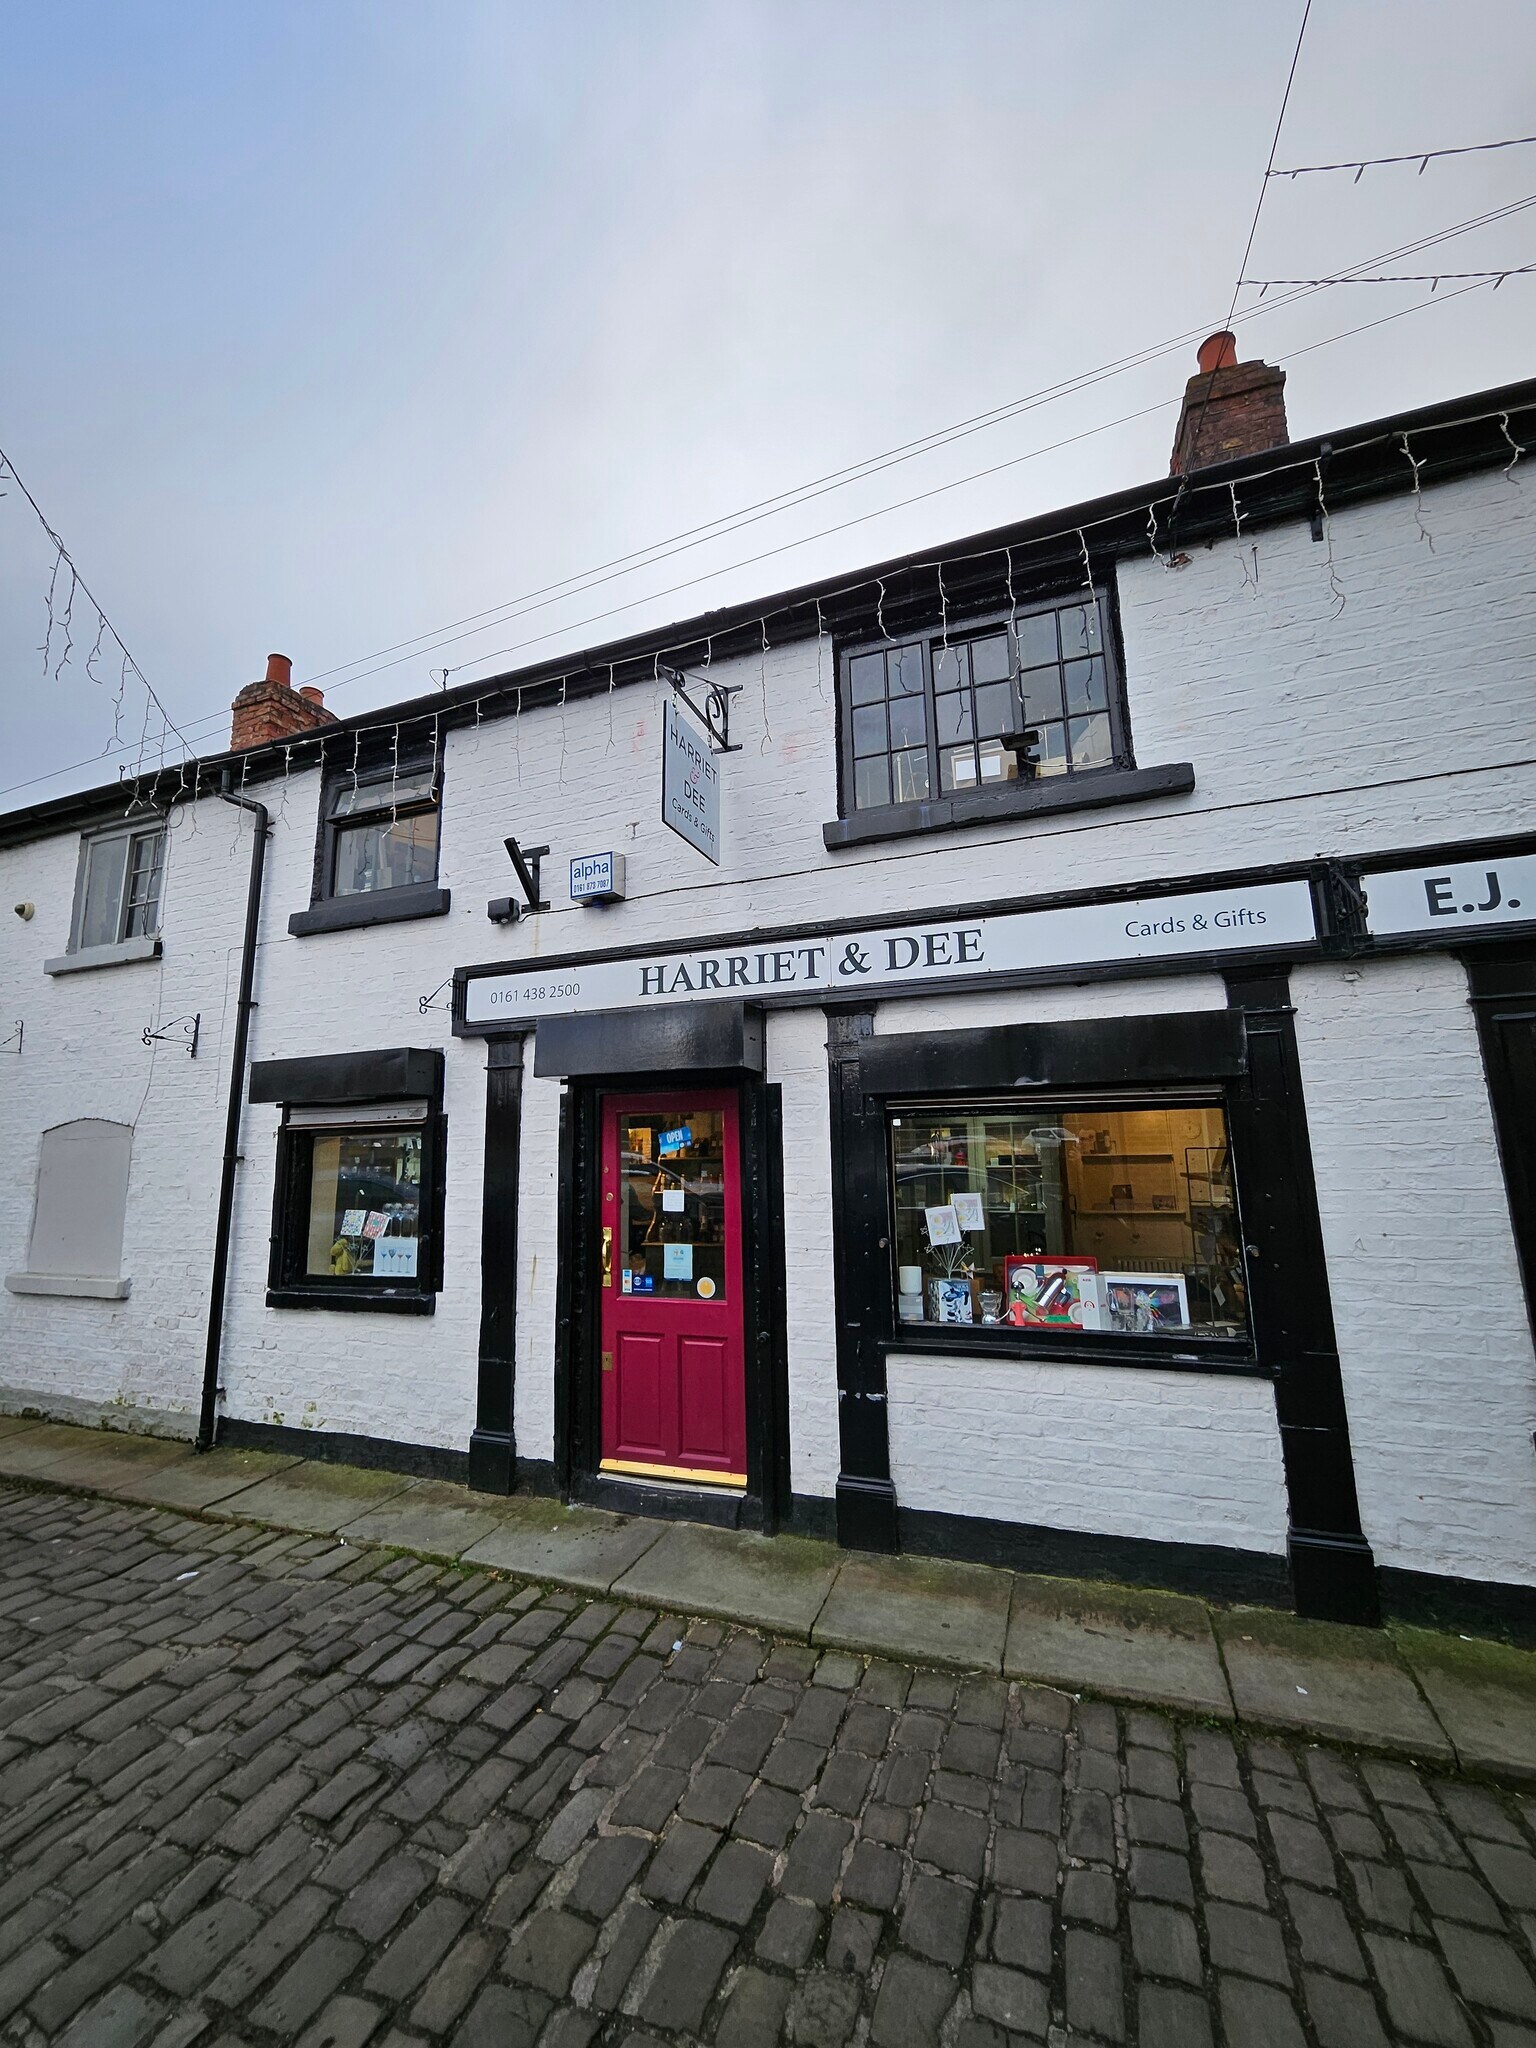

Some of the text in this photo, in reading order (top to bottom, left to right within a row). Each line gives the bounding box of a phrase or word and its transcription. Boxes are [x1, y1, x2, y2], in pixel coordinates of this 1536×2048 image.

[670, 723, 718, 785] HARRIET
[690, 767, 700, 784] &
[684, 780, 706, 814] DEE
[672, 797, 716, 843] Cards & Gifts
[574, 860, 609, 880] alpha
[573, 884, 586, 893] 0161
[1424, 871, 1521, 917] E.J.
[1124, 908, 1267, 938] Cards & Gifts
[638, 929, 985, 997] HARRIET & DEE
[490, 983, 581, 1005] 0161 438 2500
[666, 1130, 683, 1144] OPEN
